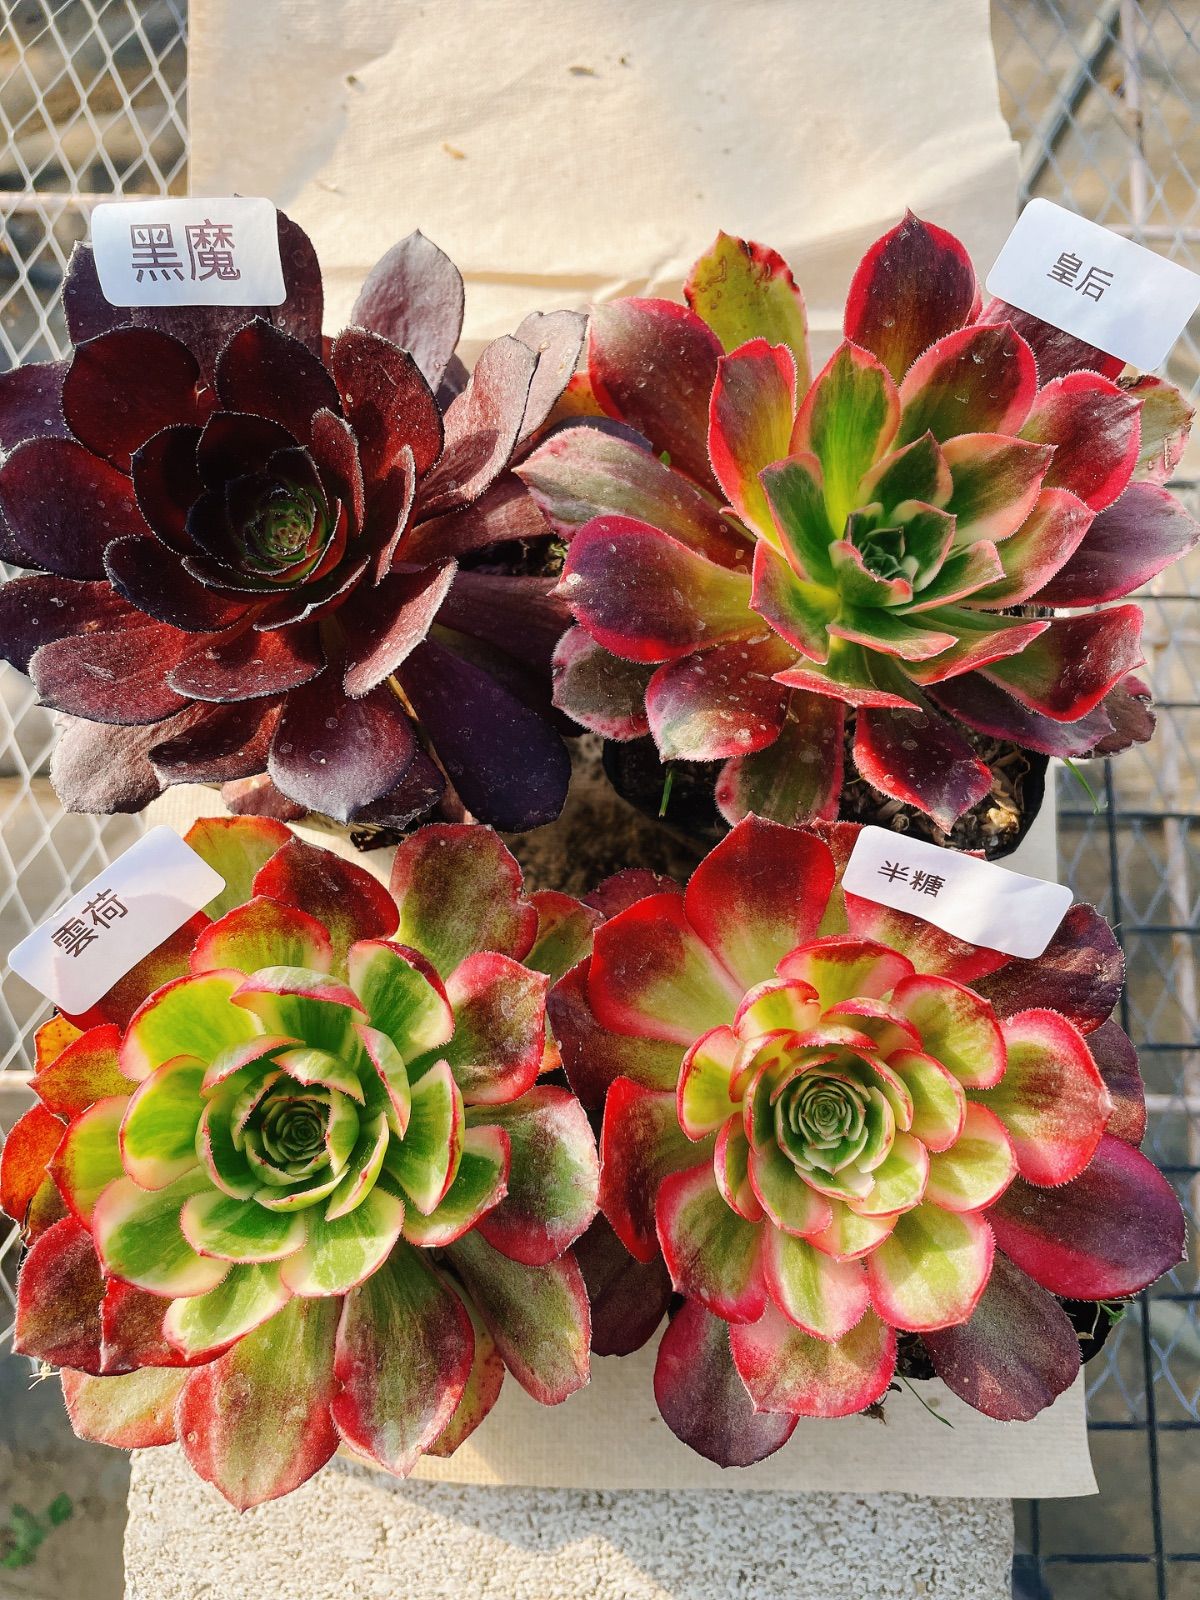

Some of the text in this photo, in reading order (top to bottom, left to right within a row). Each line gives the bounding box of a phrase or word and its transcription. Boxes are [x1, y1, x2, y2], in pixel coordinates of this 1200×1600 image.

[130, 218, 241, 283] 黑魔
[1046, 251, 1114, 302] 皇后
[877, 860, 946, 898] 半糖
[50, 888, 129, 958] 雲荷
